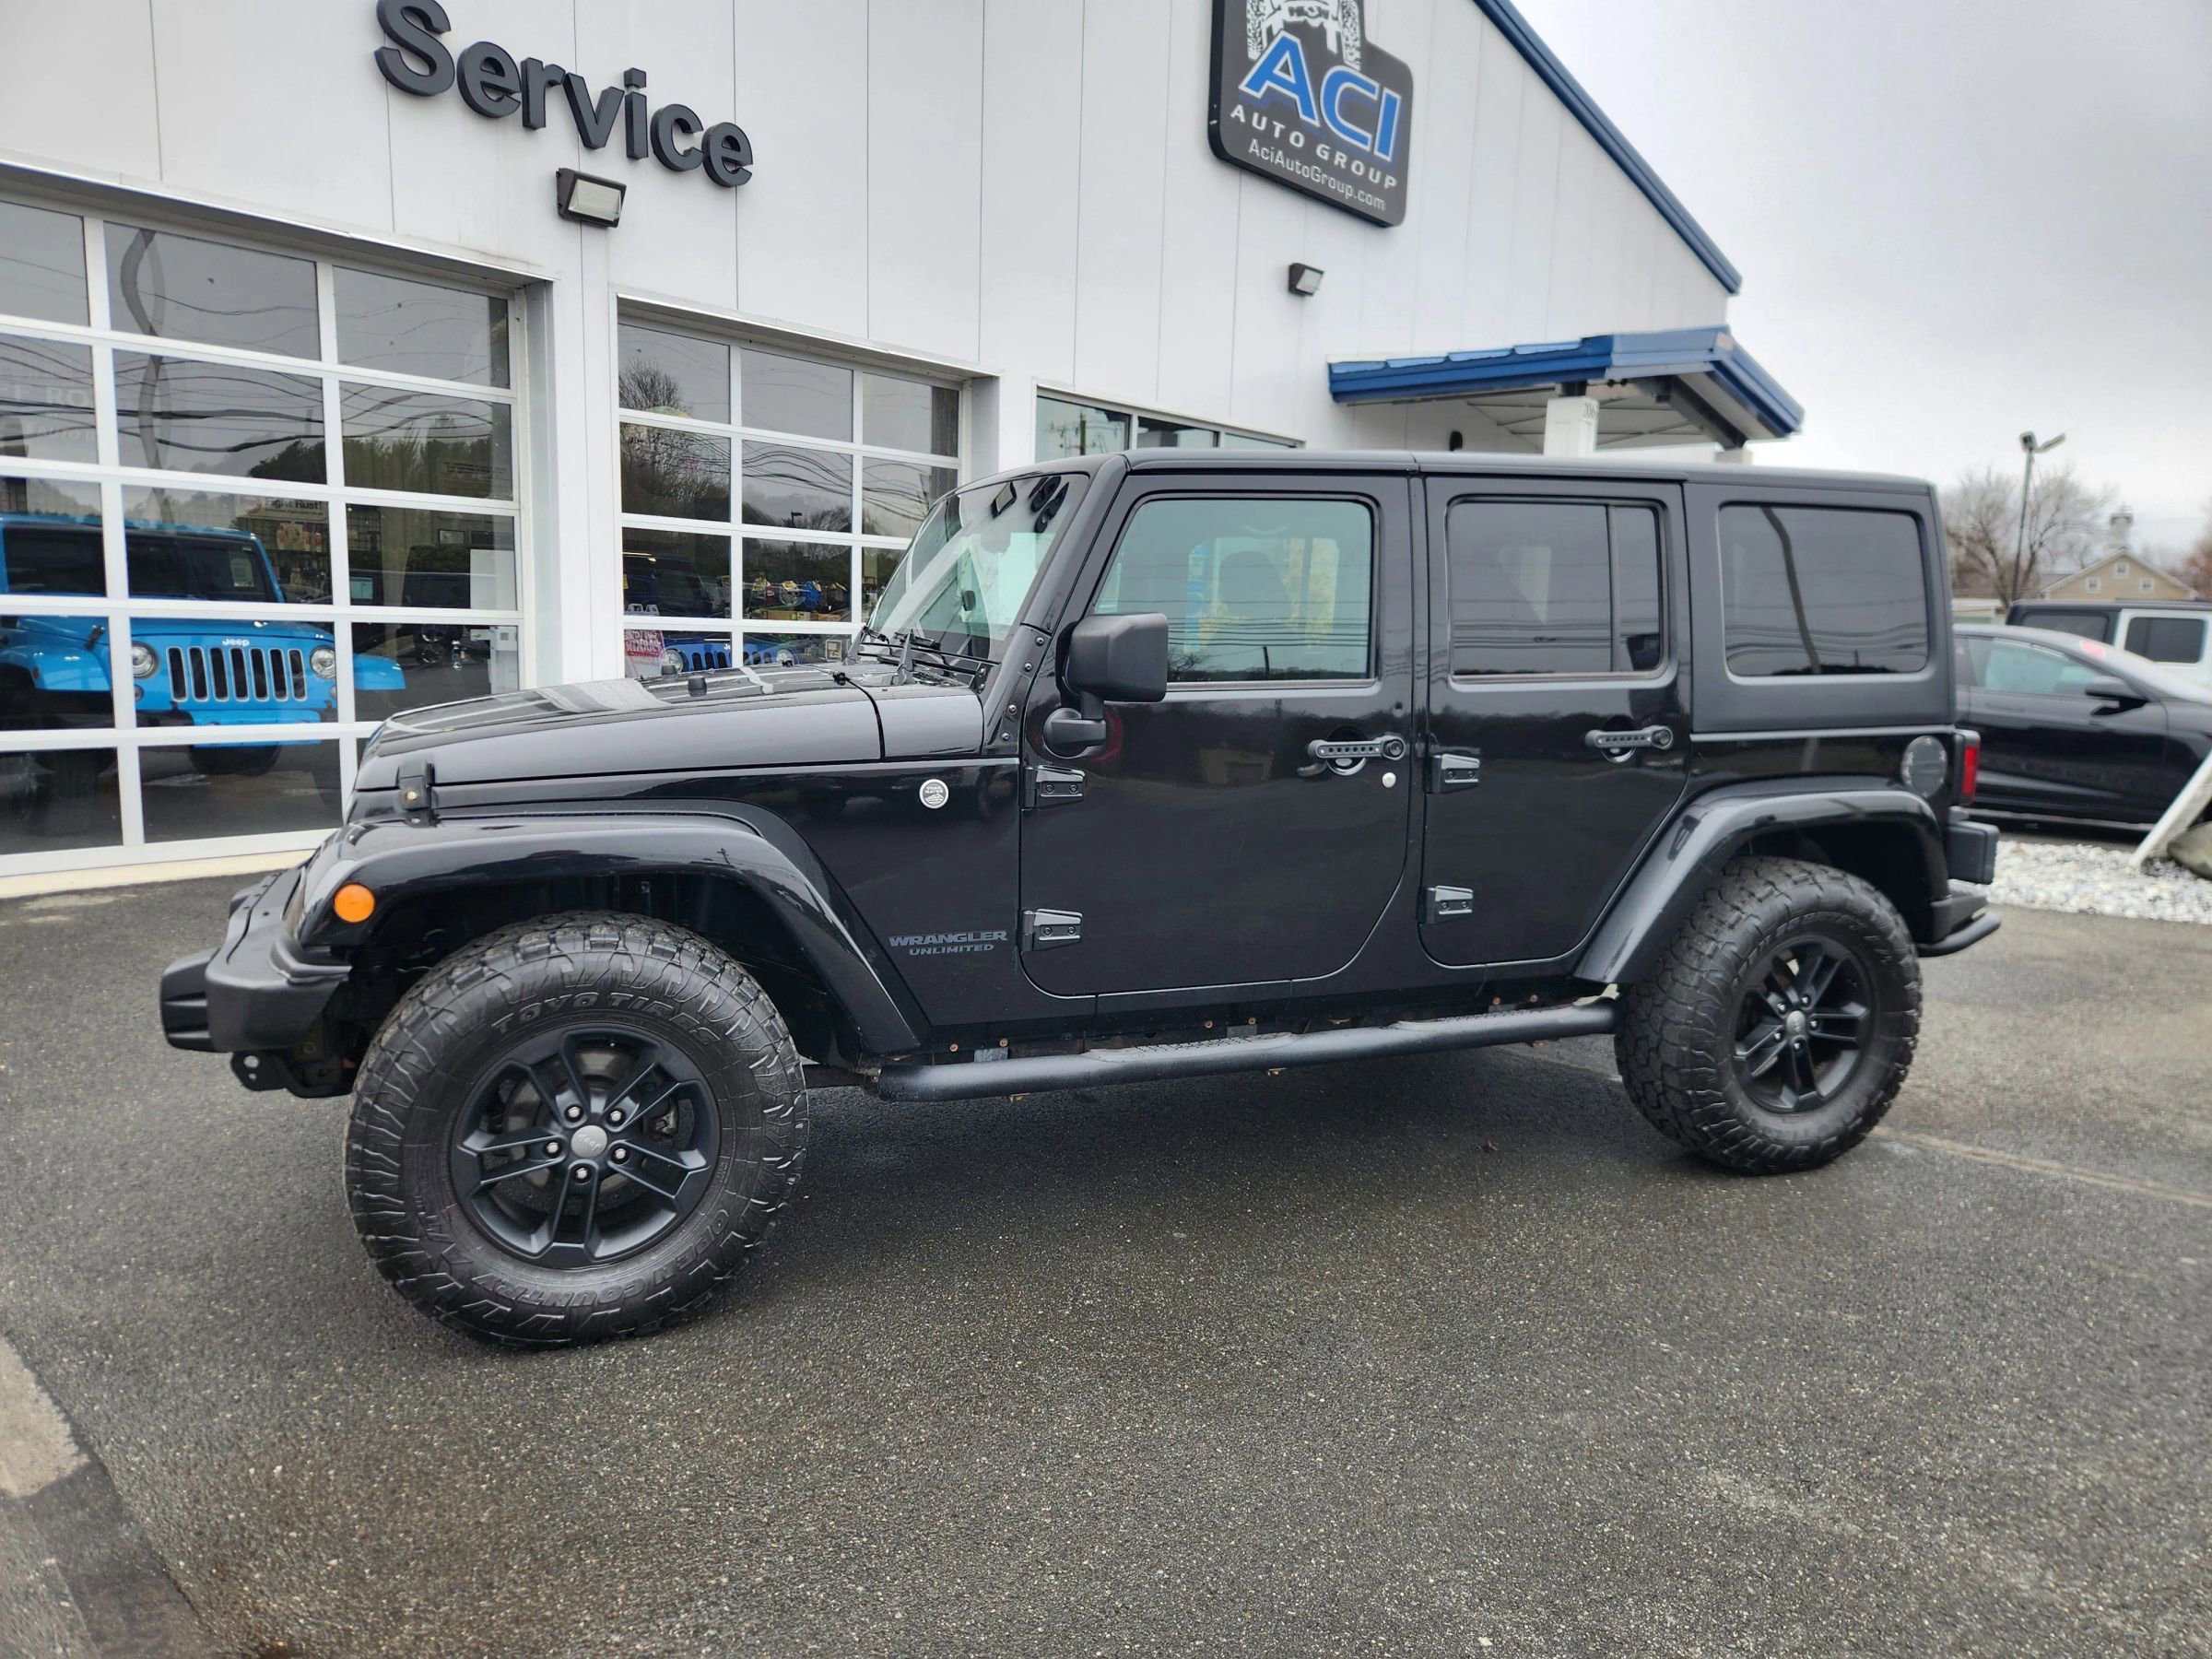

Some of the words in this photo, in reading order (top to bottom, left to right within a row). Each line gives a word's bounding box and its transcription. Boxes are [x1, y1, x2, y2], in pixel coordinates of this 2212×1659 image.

[375, 0, 753, 187] Service
[1238, 30, 1401, 162] ACI
[1230, 103, 1306, 148] AUTO
[1315, 145, 1398, 190] GROUP
[1248, 138, 1387, 212] AciAutoGroup.com
[221, 638, 250, 647] Jeep
[888, 931, 1007, 947] WRANGLER
[908, 944, 994, 956] UNLIMITED
[491, 992, 599, 1034] TOYO
[608, 992, 721, 1046] TIRES
[471, 1273, 645, 1308] COUNTRY
